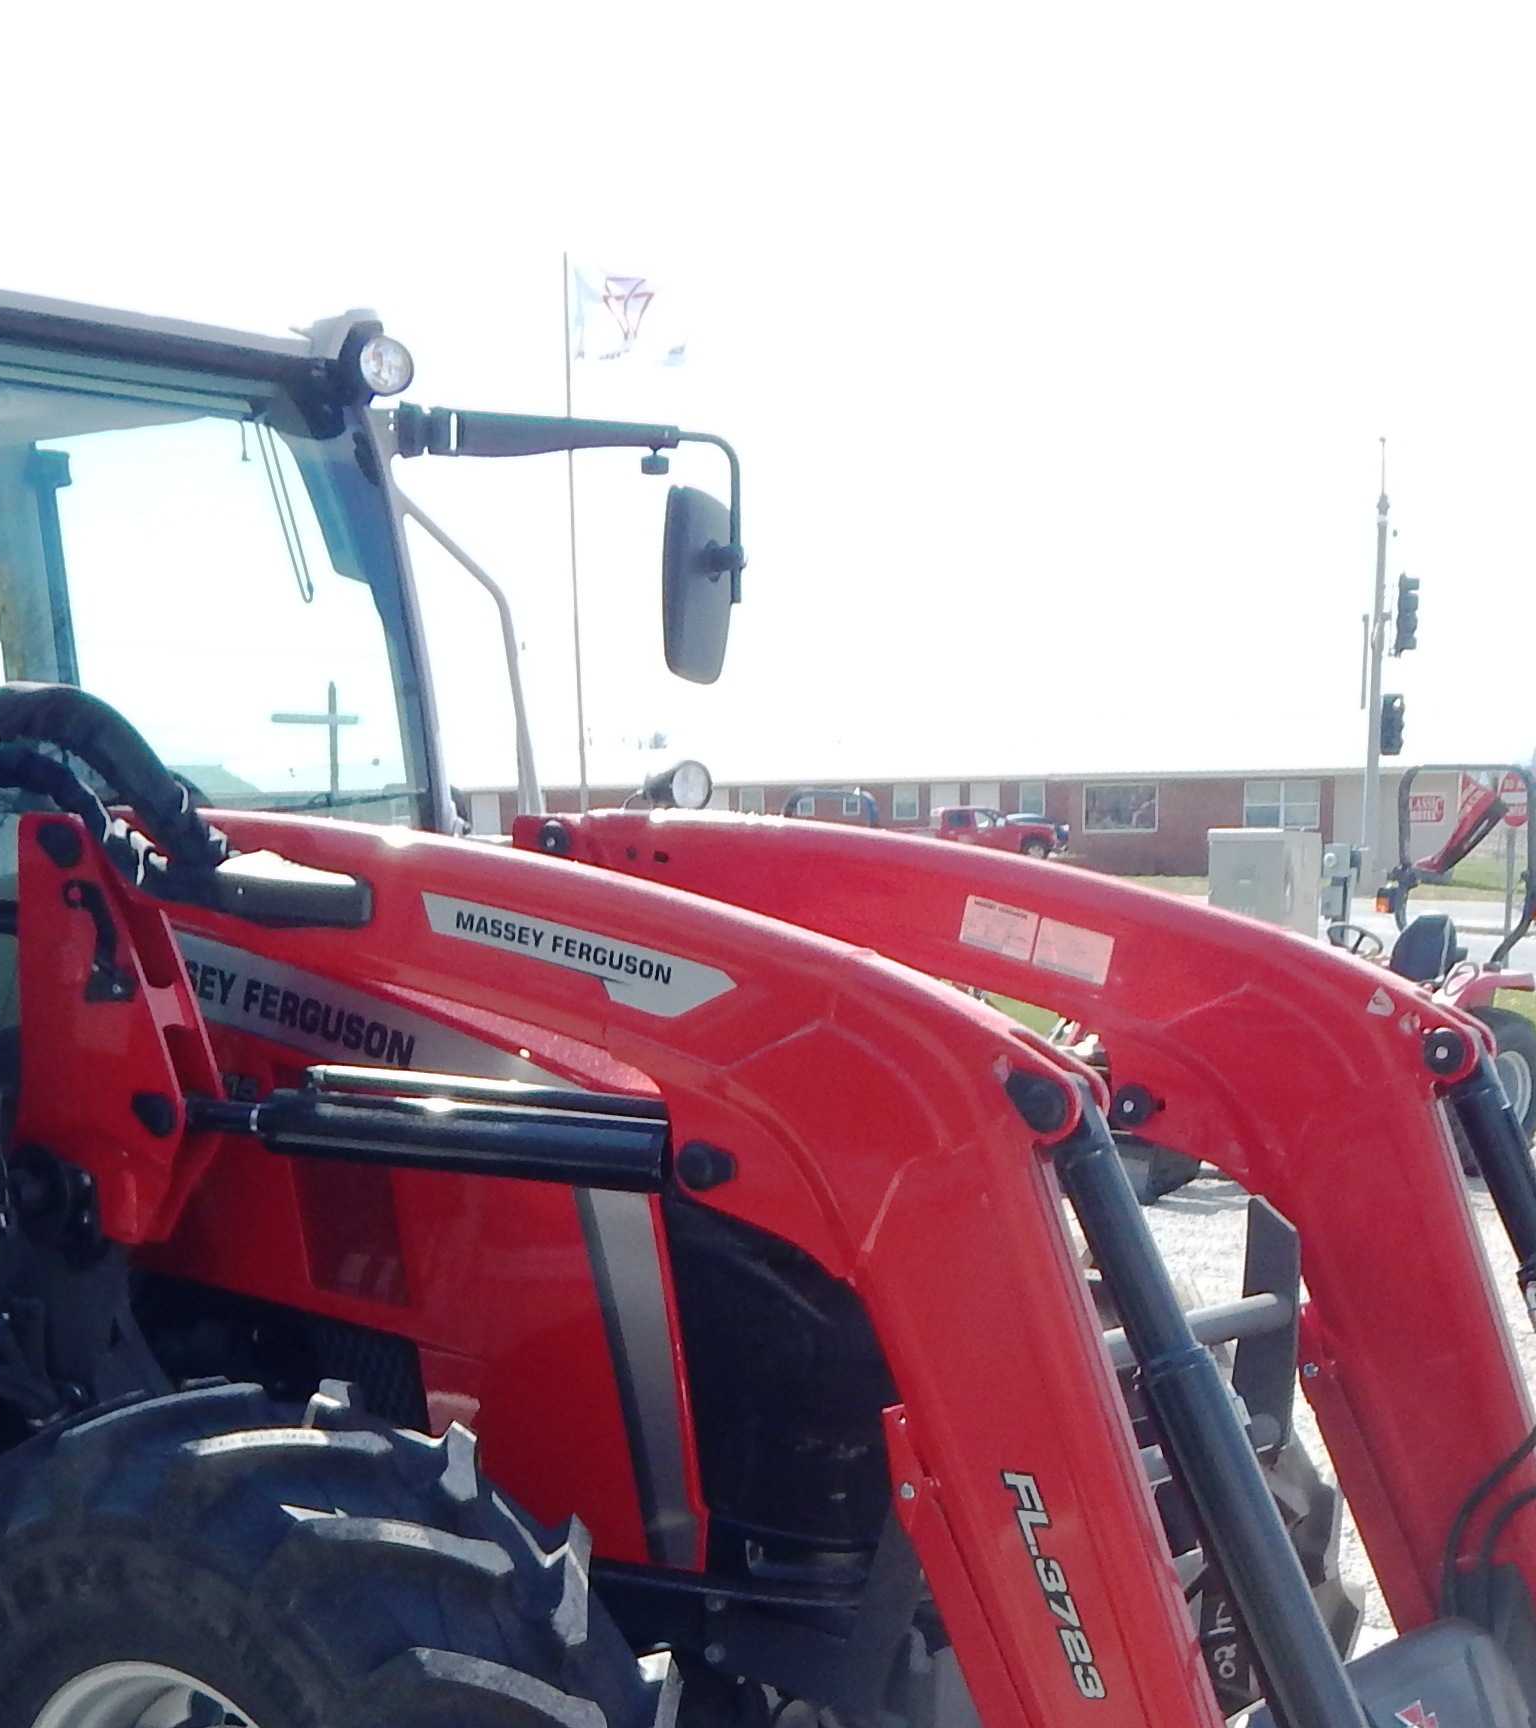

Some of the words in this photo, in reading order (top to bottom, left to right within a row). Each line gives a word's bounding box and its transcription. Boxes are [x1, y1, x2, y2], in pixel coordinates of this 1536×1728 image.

[455, 911, 544, 948] MASSEY
[551, 935, 672, 985] FERGUSON
[184, 959, 238, 1006] SEY
[242, 978, 416, 1068] FERGUSON
[1001, 1470, 1108, 1700] FL.3723
